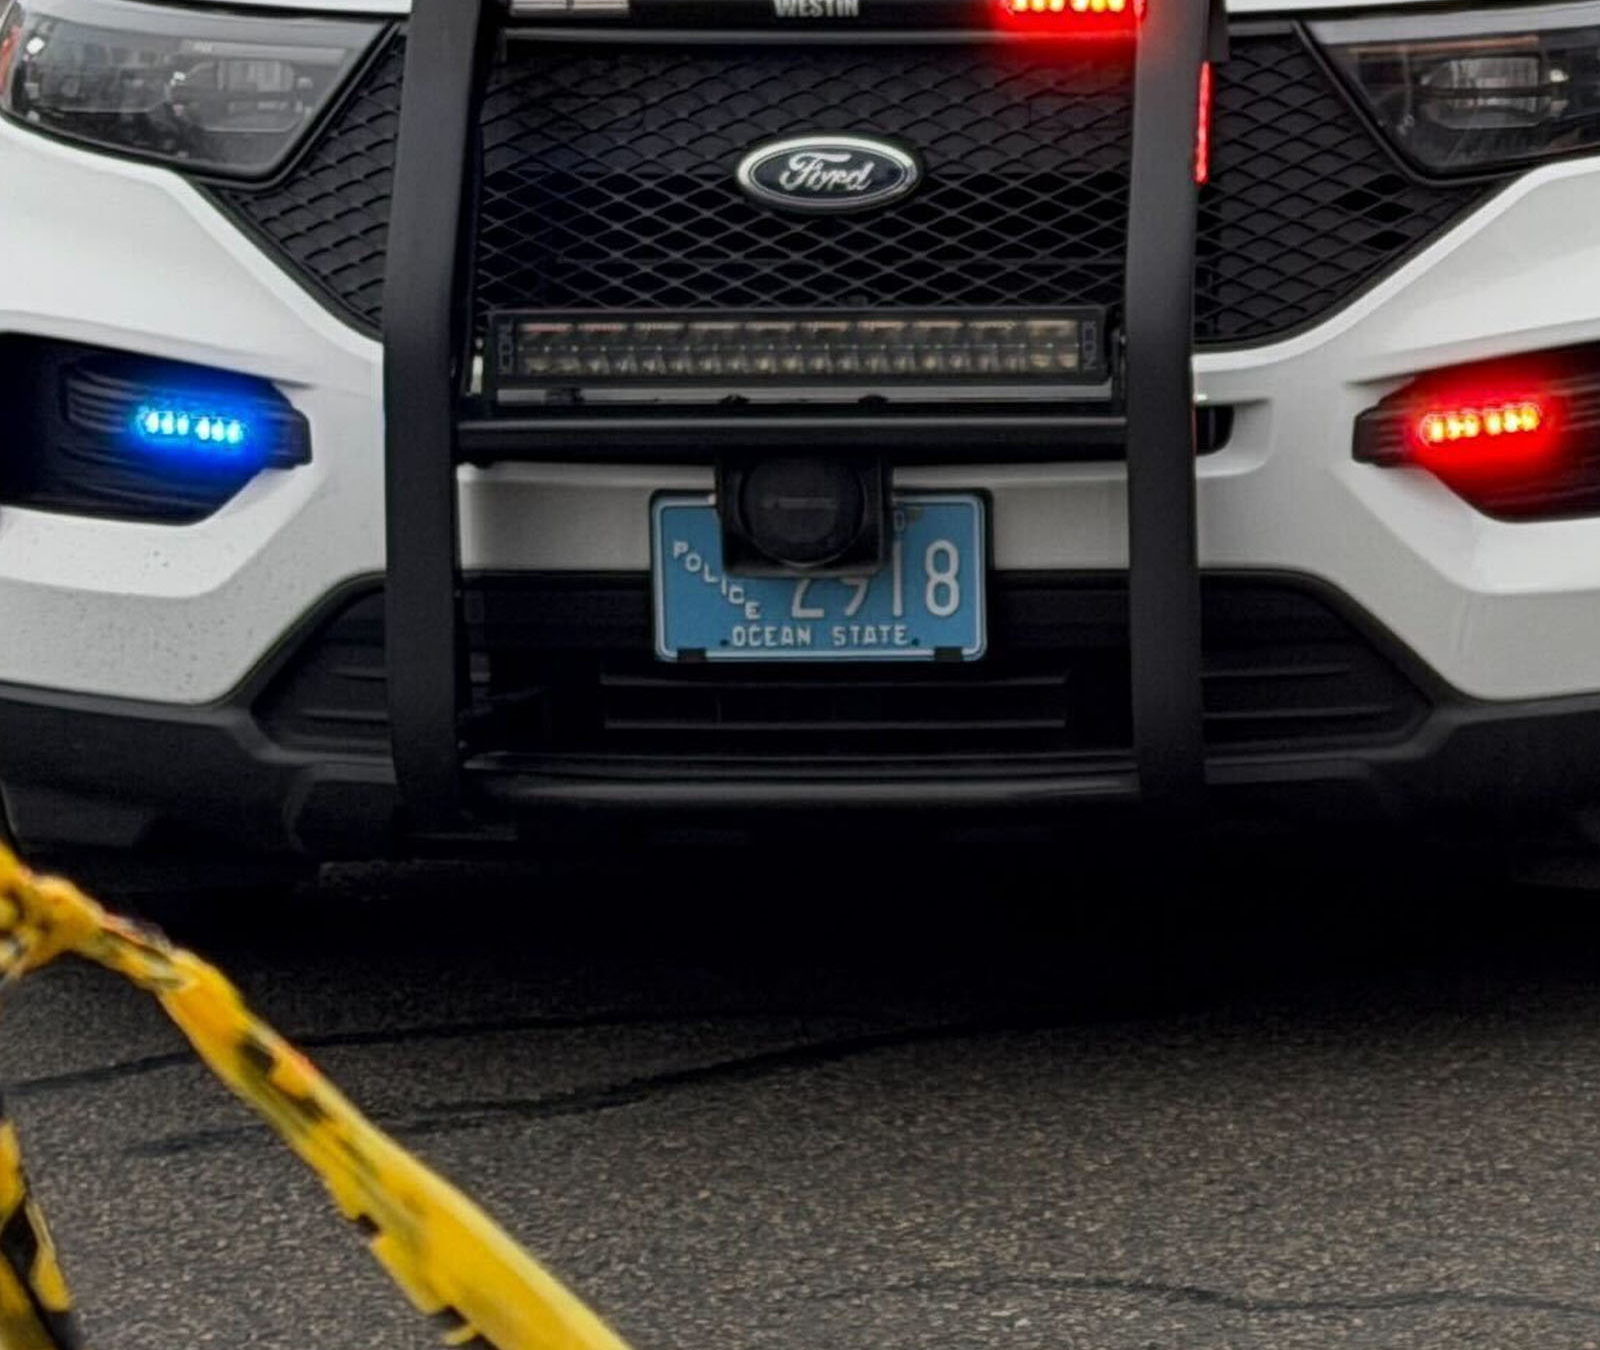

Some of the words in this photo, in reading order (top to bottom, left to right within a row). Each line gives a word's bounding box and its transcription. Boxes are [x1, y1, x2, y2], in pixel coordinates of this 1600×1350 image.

[779, 152, 875, 192] Ford
[672, 539, 761, 621] POLICE
[732, 625, 812, 647] OCEAN
[832, 624, 908, 647] STATE
